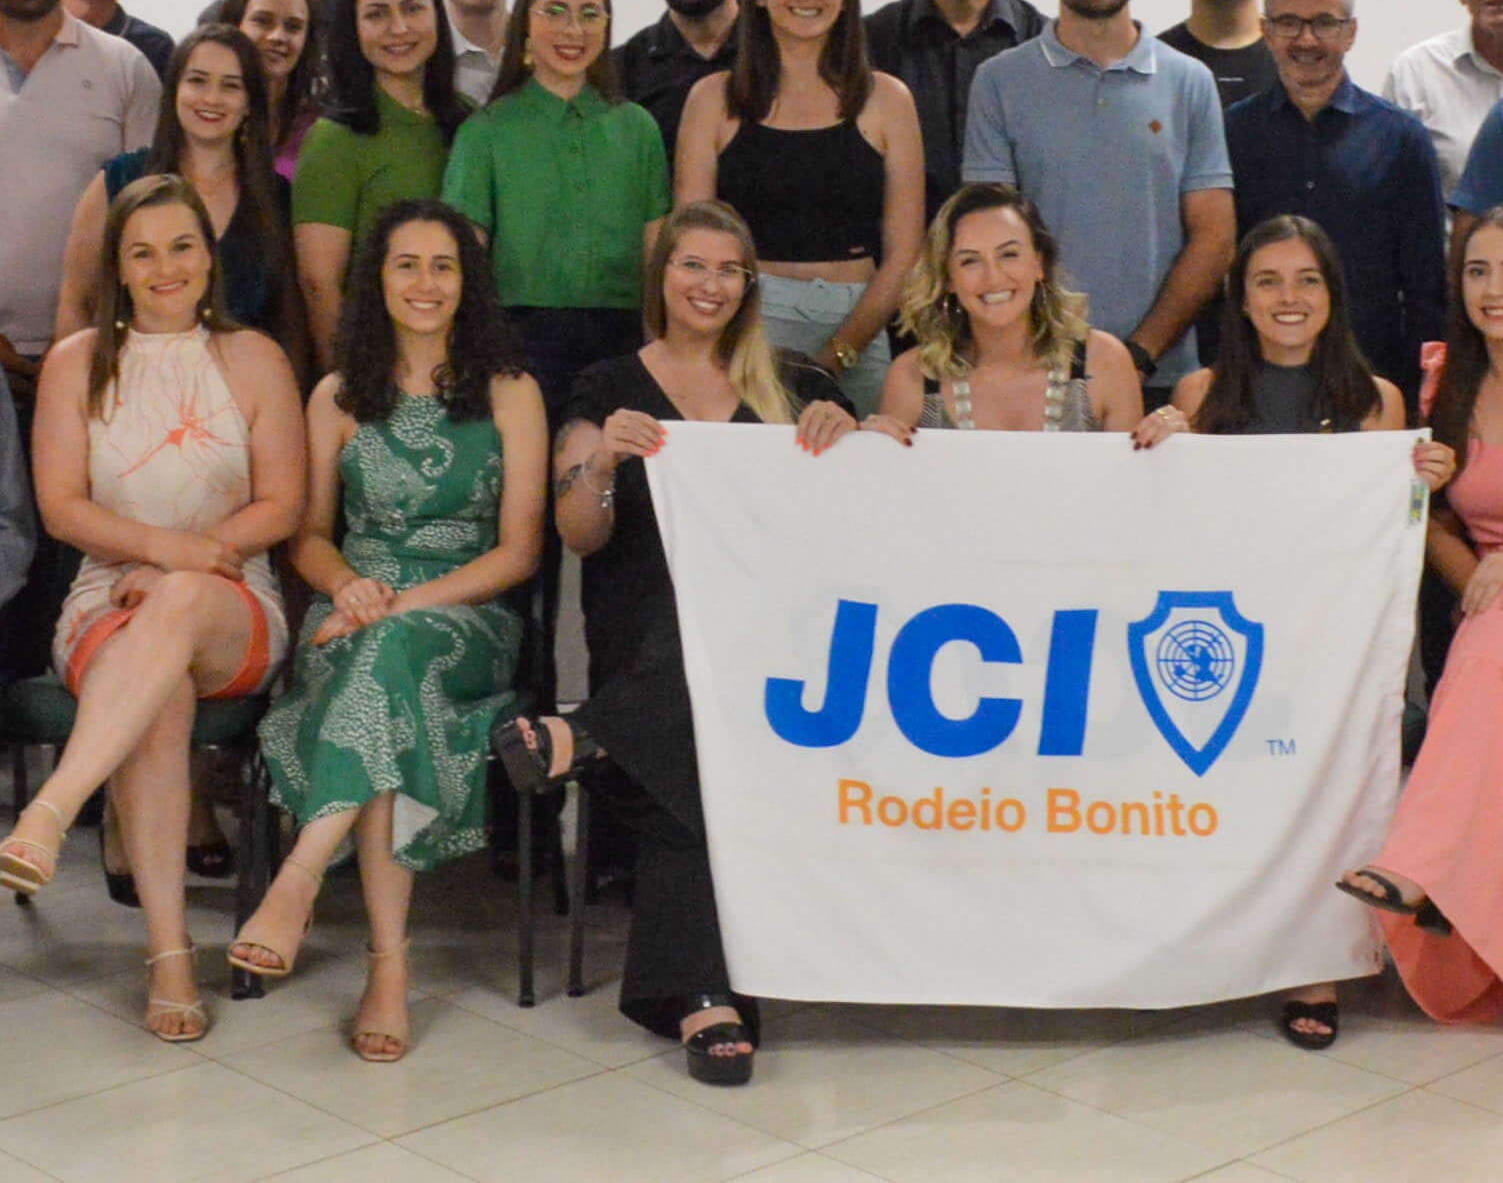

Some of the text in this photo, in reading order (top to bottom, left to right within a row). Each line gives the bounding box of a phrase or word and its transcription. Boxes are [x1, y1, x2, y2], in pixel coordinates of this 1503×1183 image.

[764, 599, 1099, 758] JCI
[838, 778, 1220, 838] Rodeio Bonito
